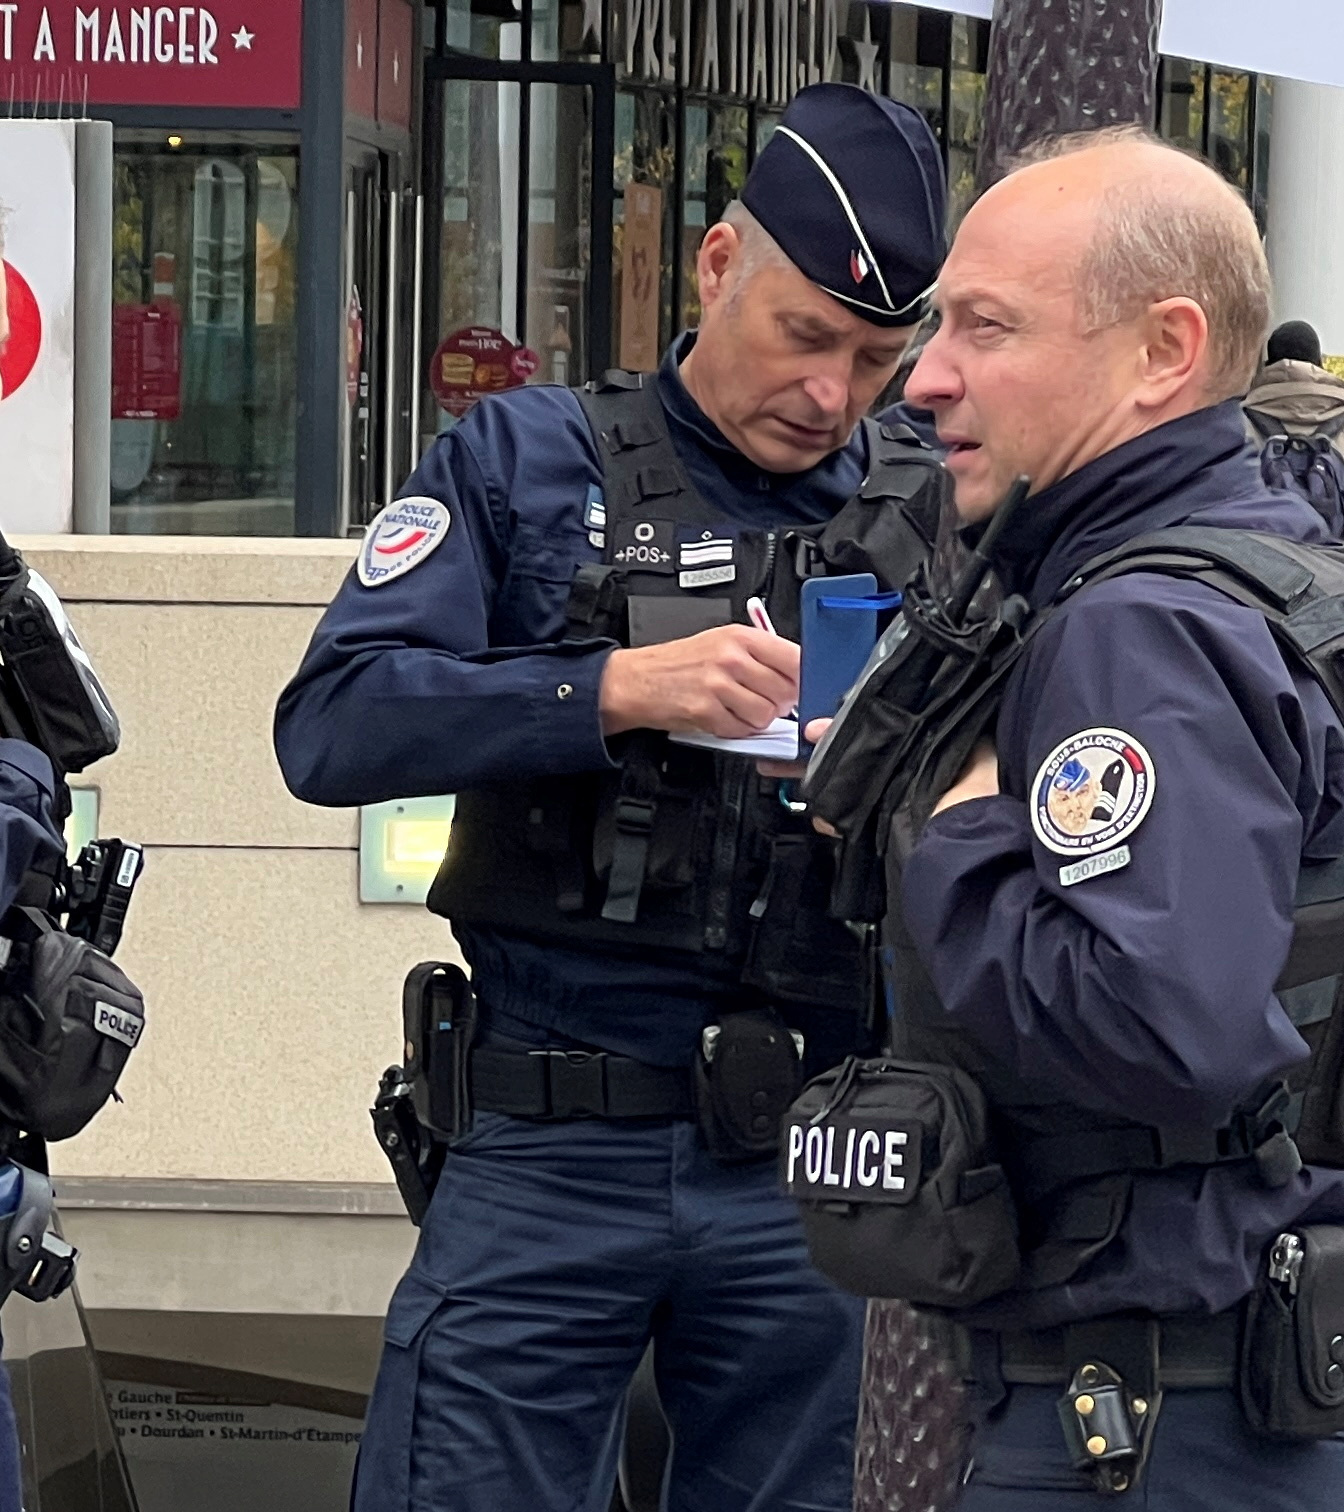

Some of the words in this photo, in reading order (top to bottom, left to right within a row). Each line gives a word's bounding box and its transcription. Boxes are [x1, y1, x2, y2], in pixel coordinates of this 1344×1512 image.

[32, 6, 56, 61] A
[75, 6, 219, 64] MANGER
[399, 504, 436, 517] POLICE
[381, 514, 441, 530] NATIONALE
[1064, 850, 1127, 882] 1207996
[99, 1009, 139, 1040] POLICE
[787, 1124, 909, 1190] POLICE
[117, 1389, 172, 1404] Gauche
[110, 1408, 151, 1421] ntiers
[165, 1408, 245, 1424] St-Quentin
[140, 1425, 205, 1439] Dourdan
[219, 1425, 362, 1444] St-Martin-d'Etampe
